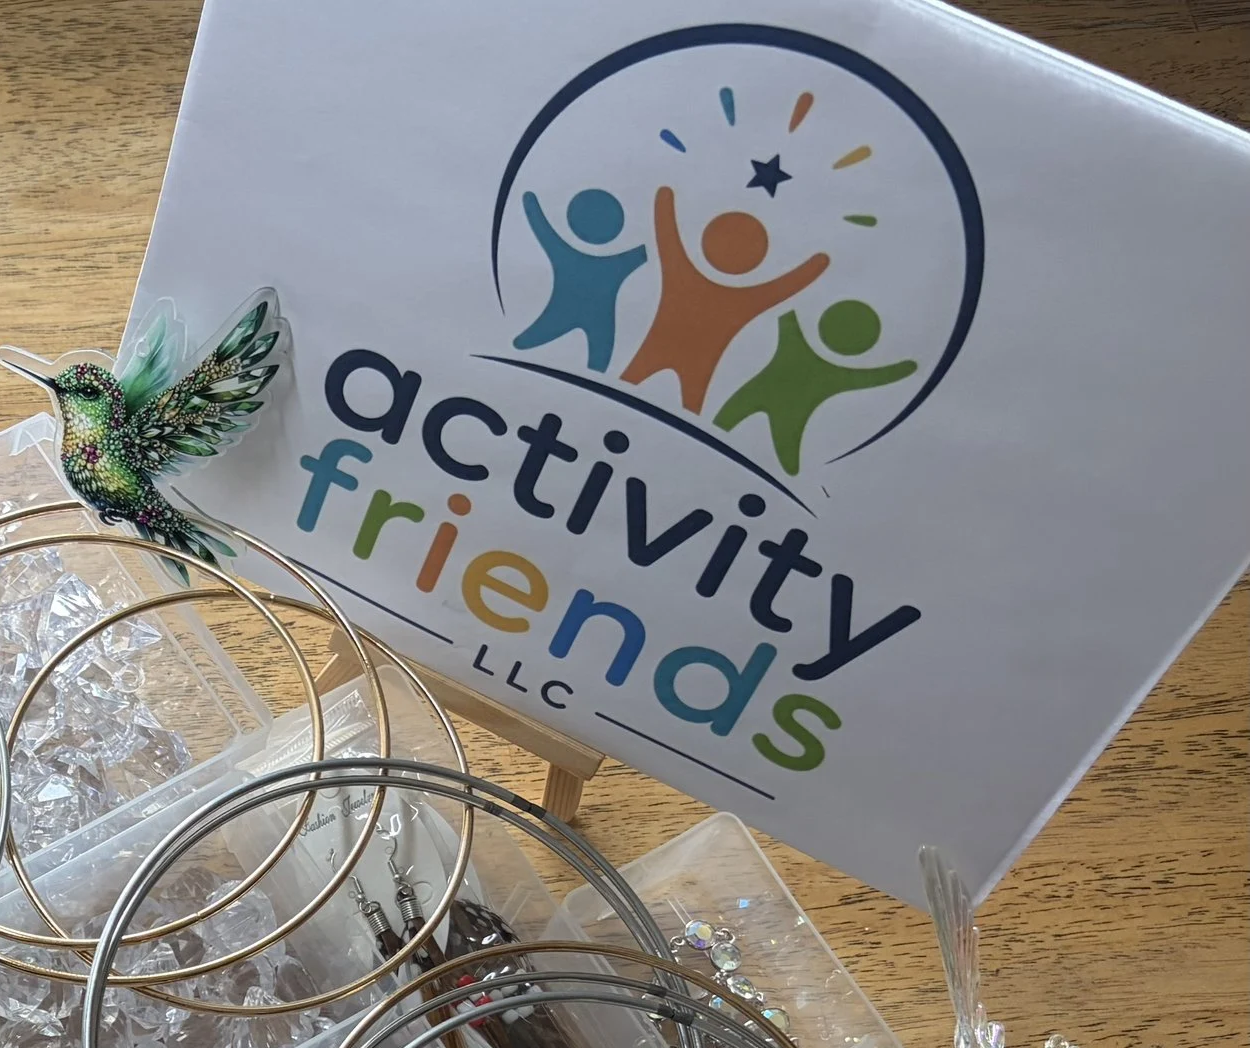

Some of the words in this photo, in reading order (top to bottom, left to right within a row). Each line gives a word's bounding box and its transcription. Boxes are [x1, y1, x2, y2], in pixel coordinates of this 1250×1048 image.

[296, 438, 842, 772] friends
[325, 349, 922, 681] activity
[472, 644, 574, 710] LLC
